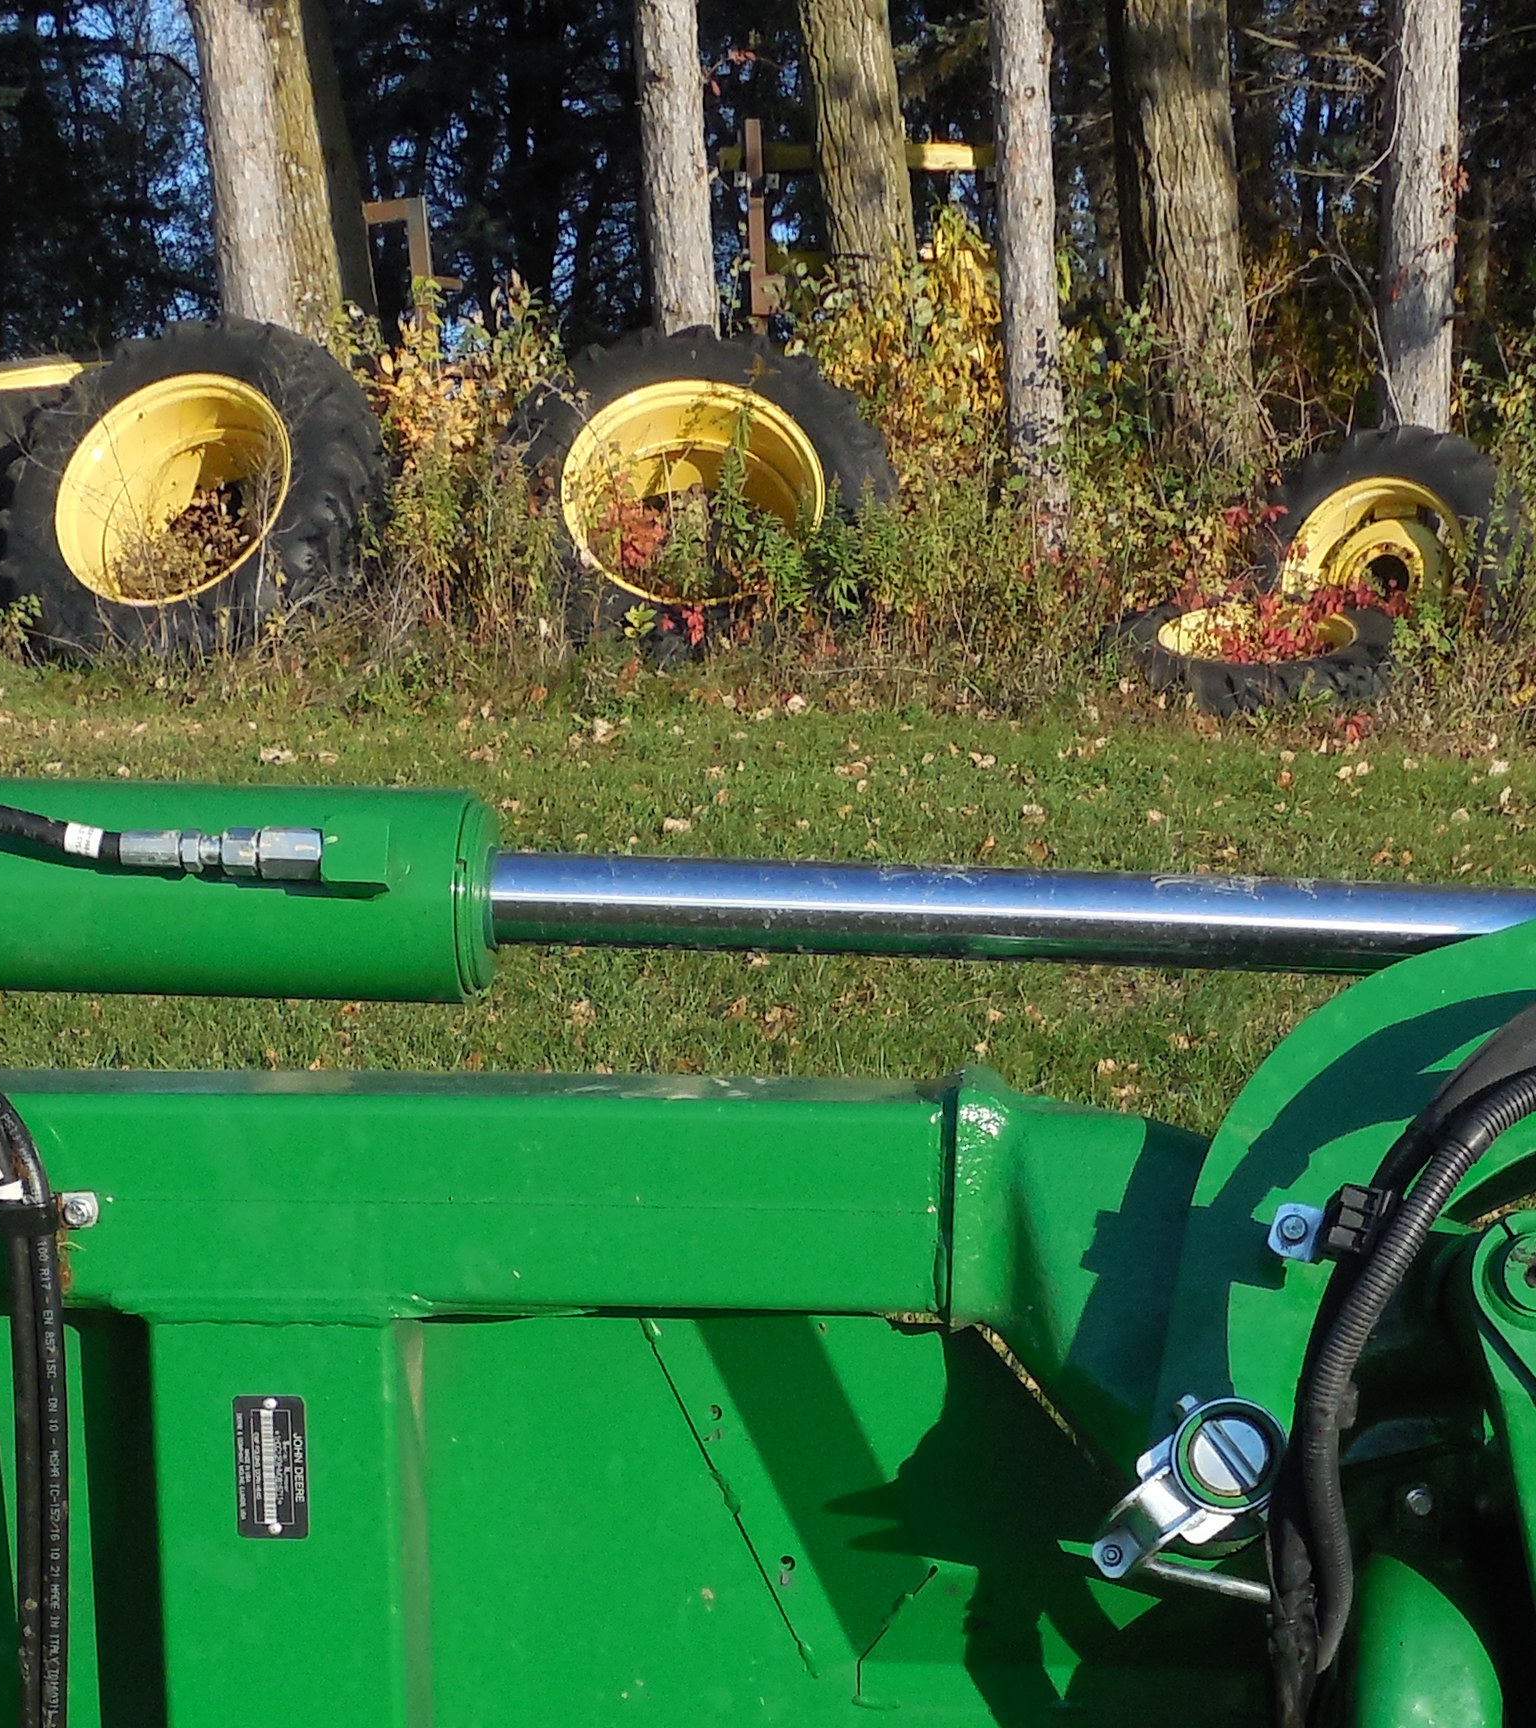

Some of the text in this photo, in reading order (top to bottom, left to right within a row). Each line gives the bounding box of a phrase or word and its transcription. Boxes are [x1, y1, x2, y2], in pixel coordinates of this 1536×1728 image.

[39, 1267, 52, 1291] R17
[42, 1309, 54, 1325] EN
[44, 1332, 57, 1354] 857
[47, 1397, 59, 1413] DN
[48, 1419, 59, 1433] 10
[292, 1432, 305, 1503] JOHN DEERE
[49, 1583, 61, 1610] MADE
[50, 1615, 61, 1629] IN
[48, 1633, 61, 1665] ITALY
